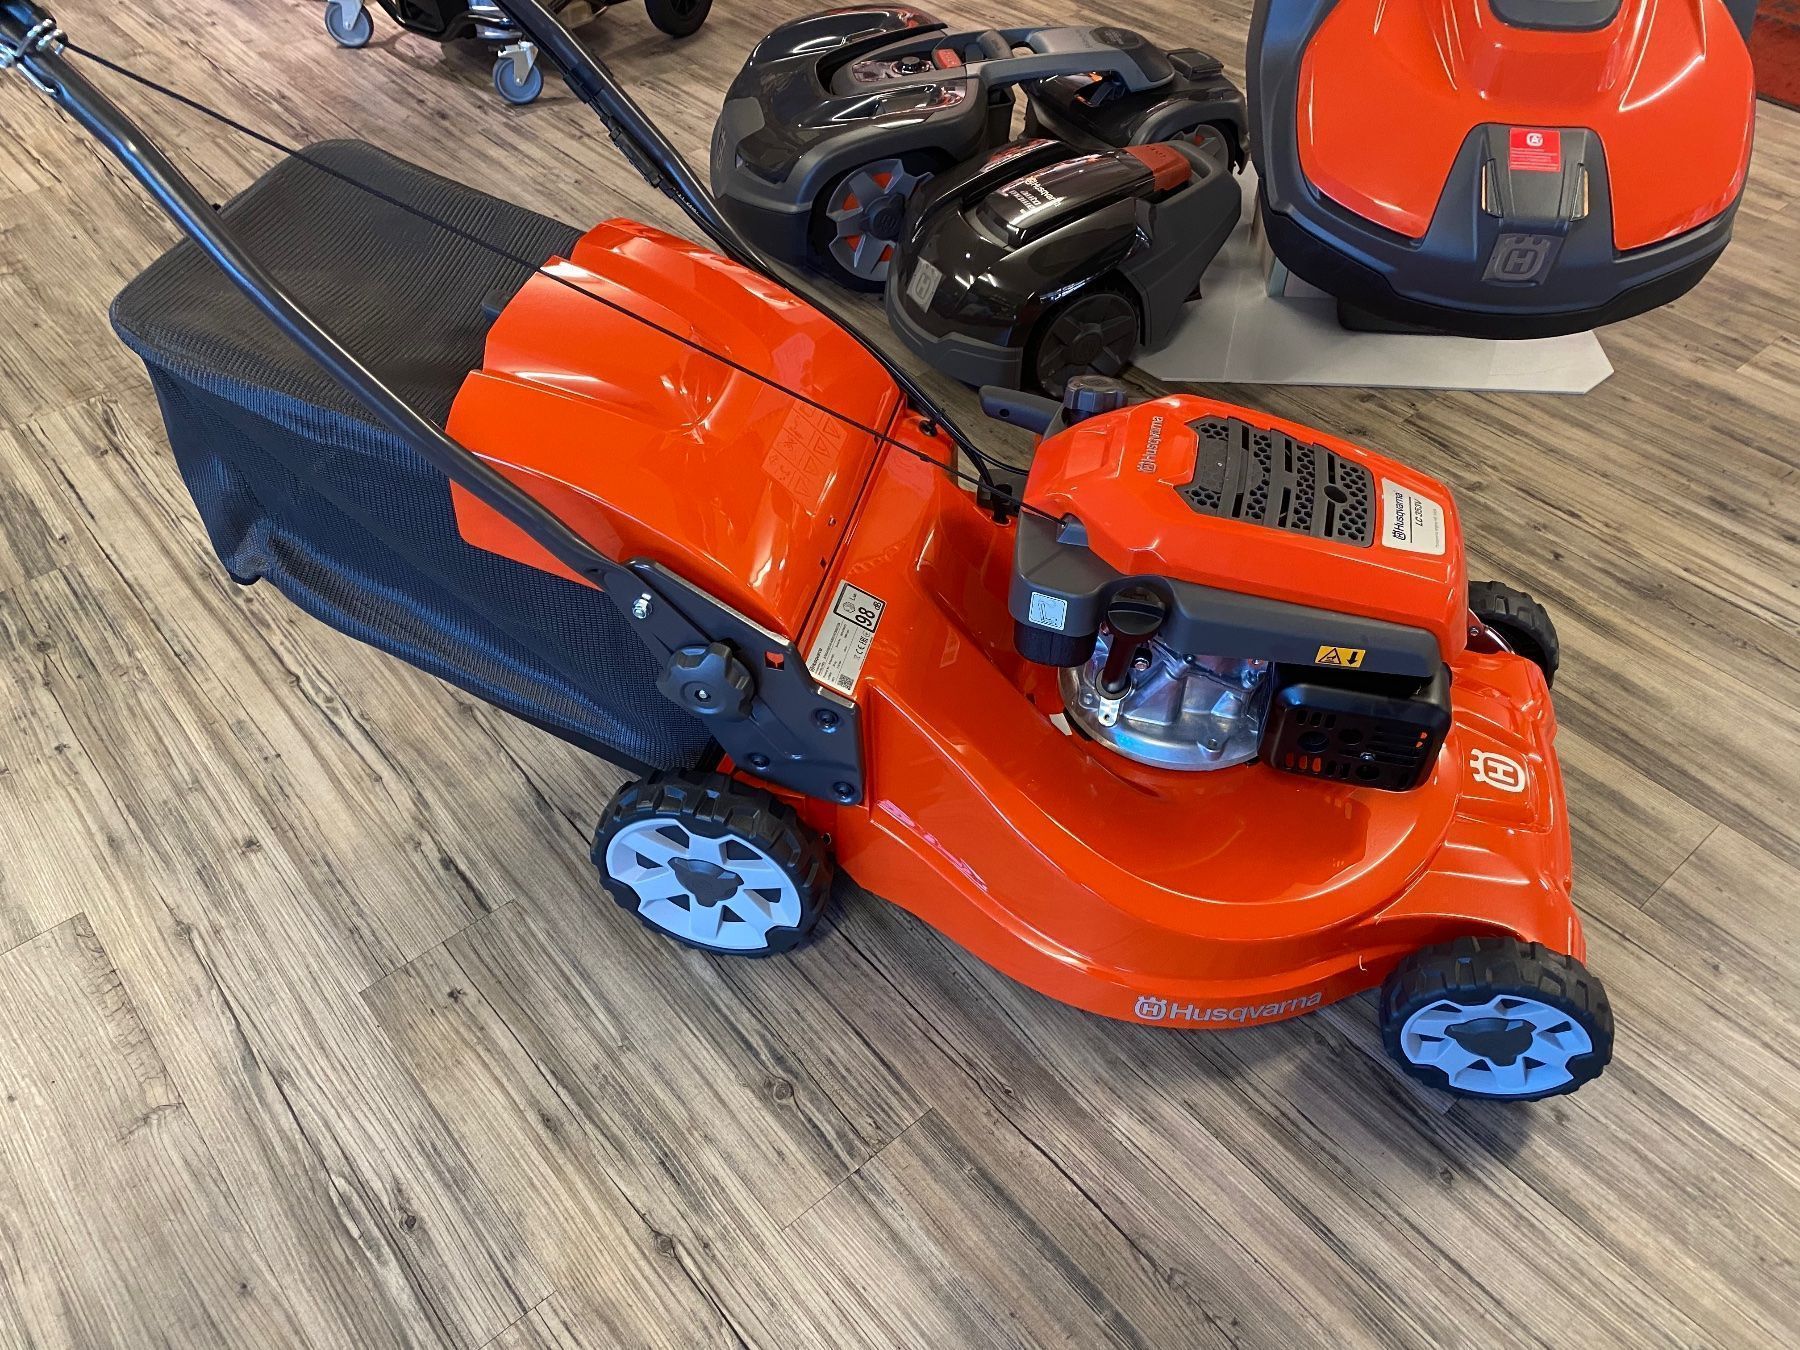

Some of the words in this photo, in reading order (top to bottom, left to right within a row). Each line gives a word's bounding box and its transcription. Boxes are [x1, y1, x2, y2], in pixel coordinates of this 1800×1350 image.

[1143, 416, 1164, 462] Husqvarna
[1393, 492, 1406, 532] Husqvarna
[854, 606, 876, 627] 98
[1169, 991, 1322, 1022] Husqvarna
